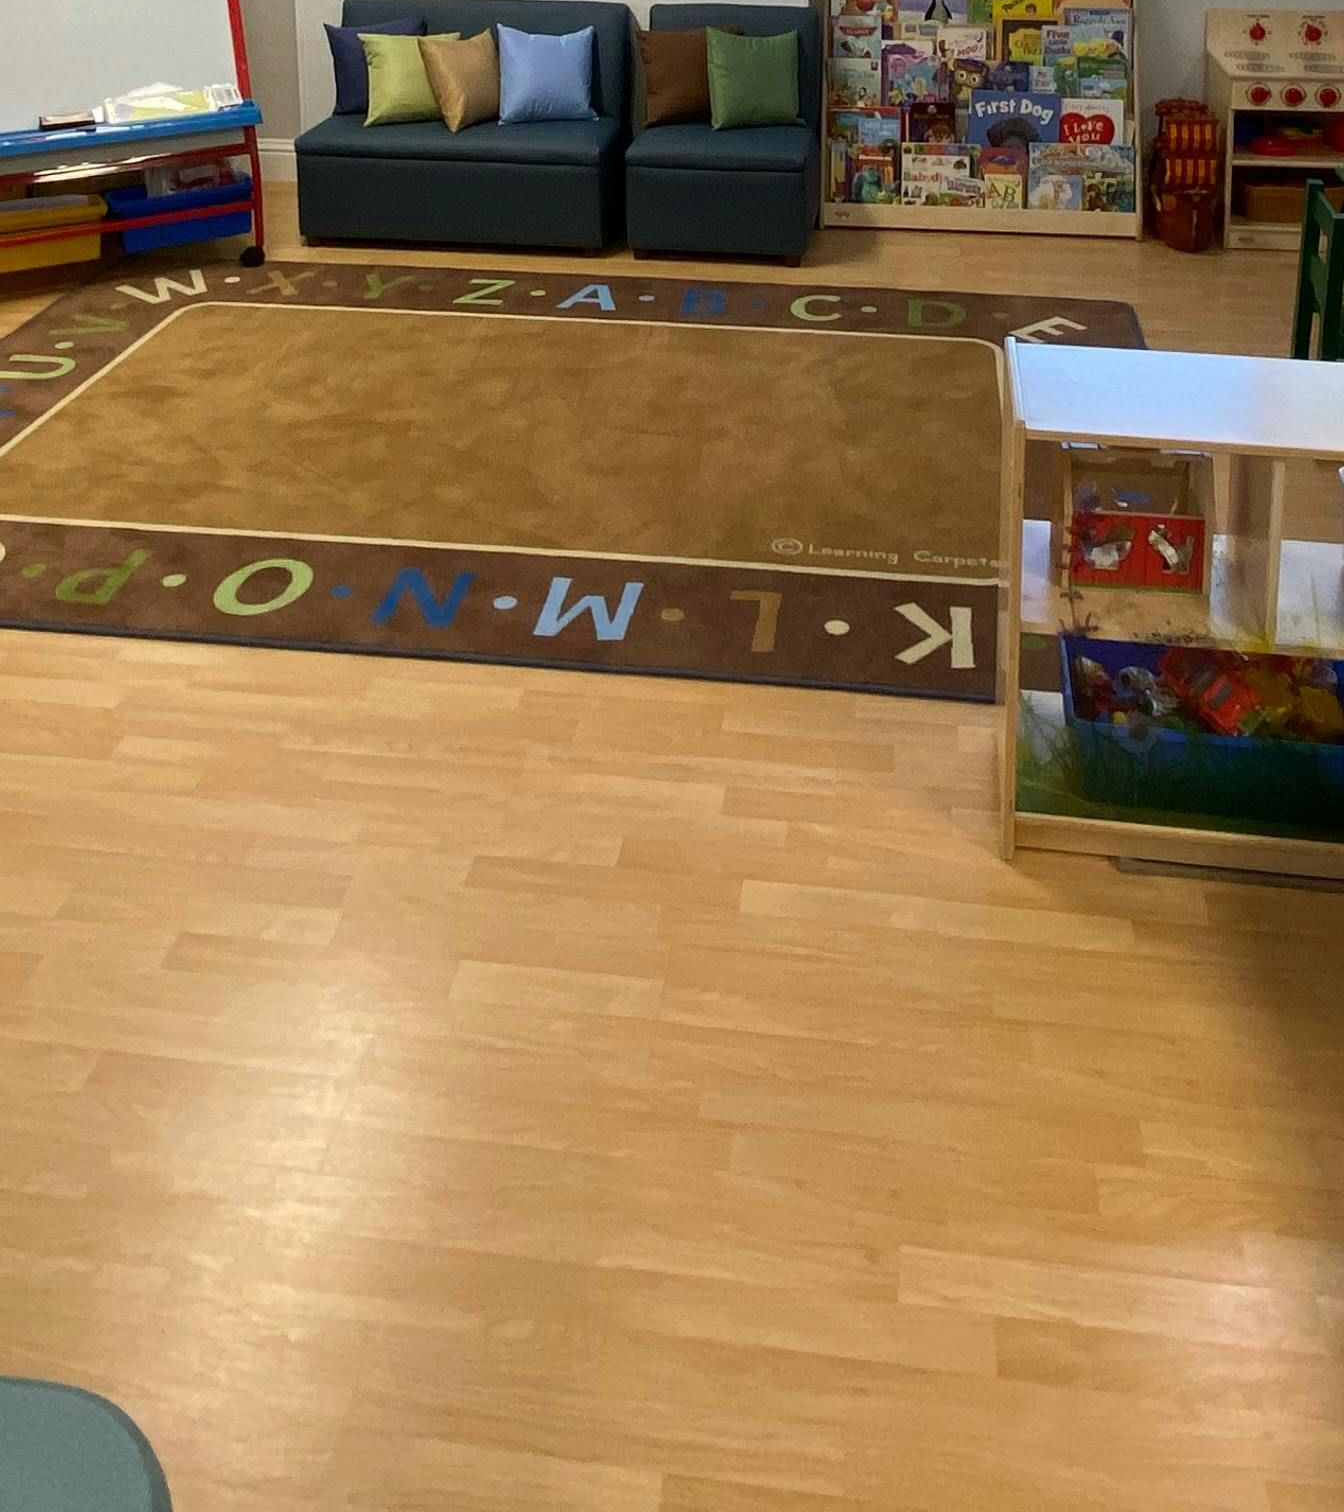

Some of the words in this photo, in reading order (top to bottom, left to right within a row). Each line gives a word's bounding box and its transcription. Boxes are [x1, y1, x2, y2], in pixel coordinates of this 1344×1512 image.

[974, 98, 1016, 118] First
[1019, 98, 1054, 126] Dog
[986, 181, 1002, 199] A
[116, 270, 207, 304] W
[247, 271, 316, 296] X
[363, 274, 415, 299] Y
[452, 278, 516, 305] Z
[557, 284, 616, 311] A
[678, 288, 728, 316] B
[790, 295, 843, 321] C
[907, 299, 966, 328] D
[50, 313, 129, 336] V
[809, 544, 899, 565] Learning
[55, 548, 152, 605] P
[213, 558, 314, 616] O
[372, 569, 476, 627] N
[532, 577, 644, 641] M
[730, 590, 782, 653] L
[894, 602, 976, 668] K
